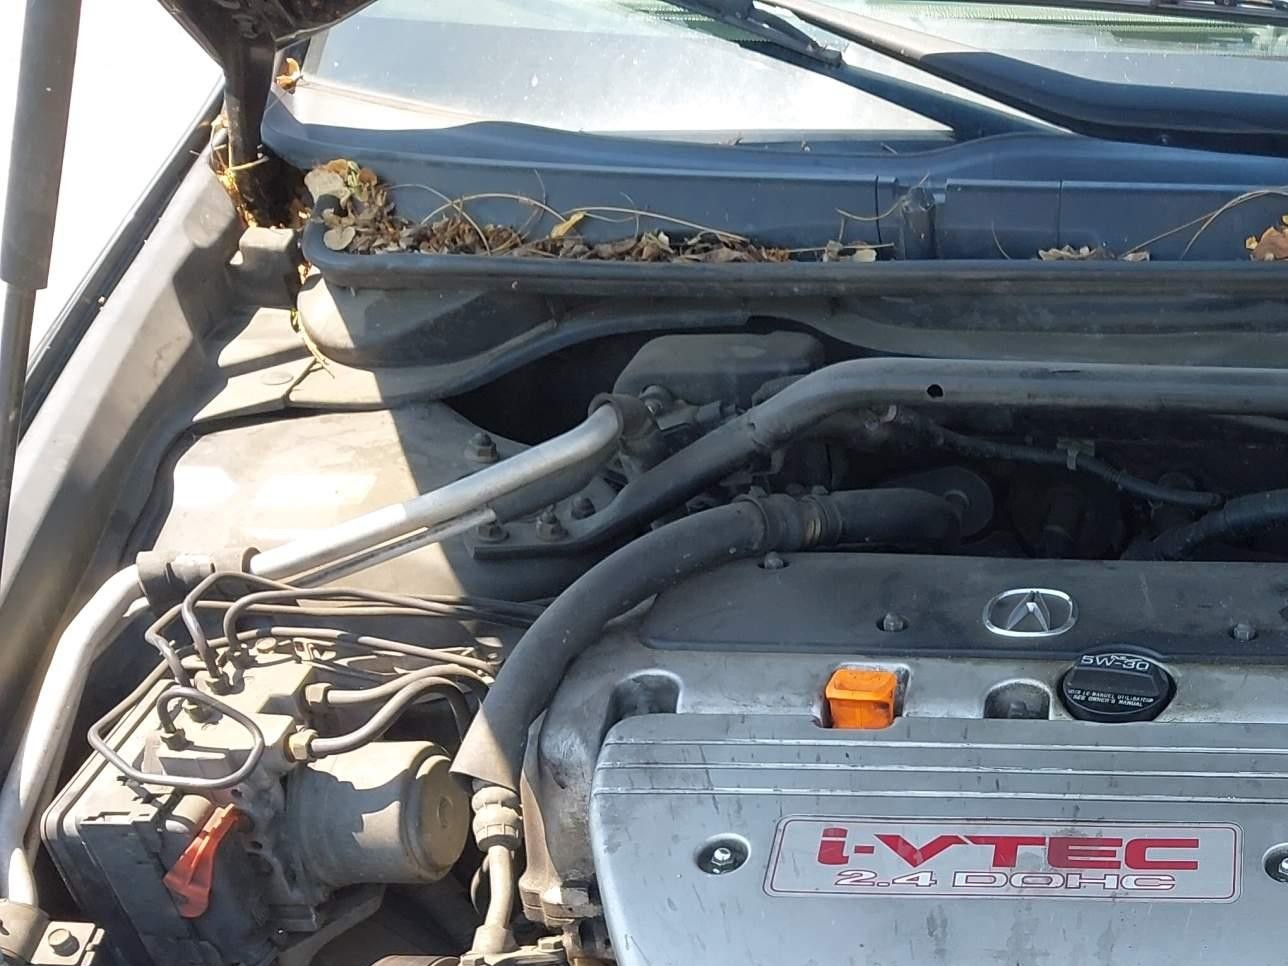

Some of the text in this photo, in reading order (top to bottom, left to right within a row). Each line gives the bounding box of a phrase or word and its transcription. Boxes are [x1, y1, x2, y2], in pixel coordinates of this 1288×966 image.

[1080, 655, 1150, 670] 5W-30
[1087, 696, 1116, 704] OWNER'S
[1091, 691, 1115, 699] MANUEL
[815, 827, 1199, 870] i-VTEC
[833, 870, 1176, 891] 2.4 DOHC
